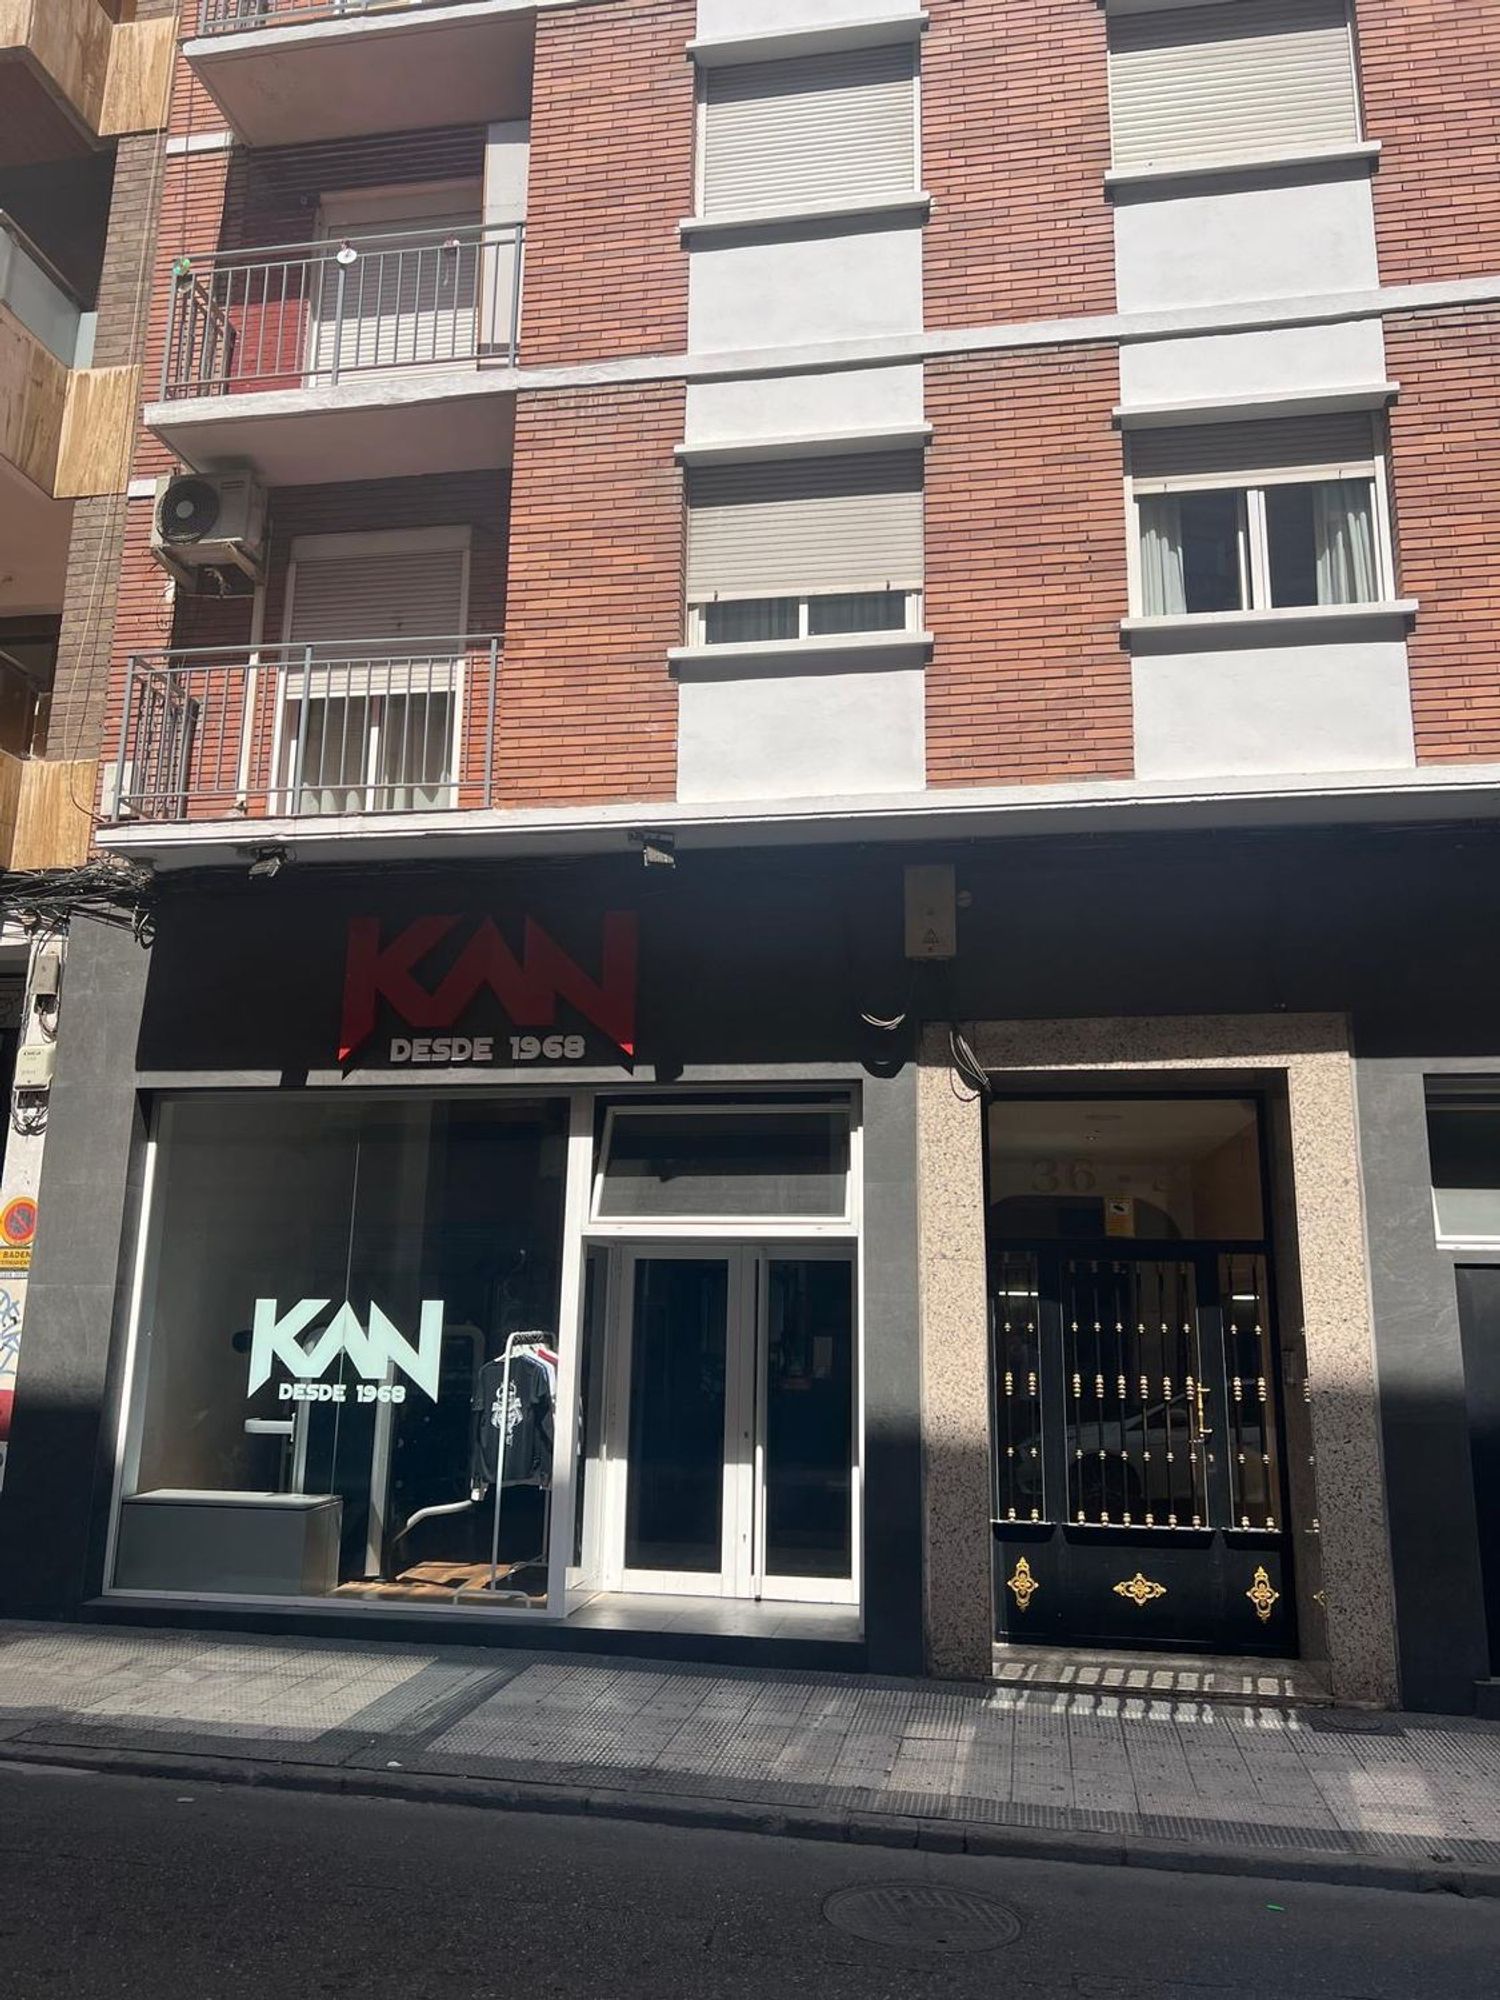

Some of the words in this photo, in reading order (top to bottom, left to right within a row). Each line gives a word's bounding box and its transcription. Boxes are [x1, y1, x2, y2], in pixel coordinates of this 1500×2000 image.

[338, 910, 638, 1063] KAN
[389, 1037, 494, 1062] DESDE
[509, 1035, 586, 1060] 1968
[1031, 1158, 1096, 1193] 36
[247, 1298, 444, 1404] KAN
[278, 1383, 347, 1402] DESDE
[356, 1384, 406, 1403] 1968
